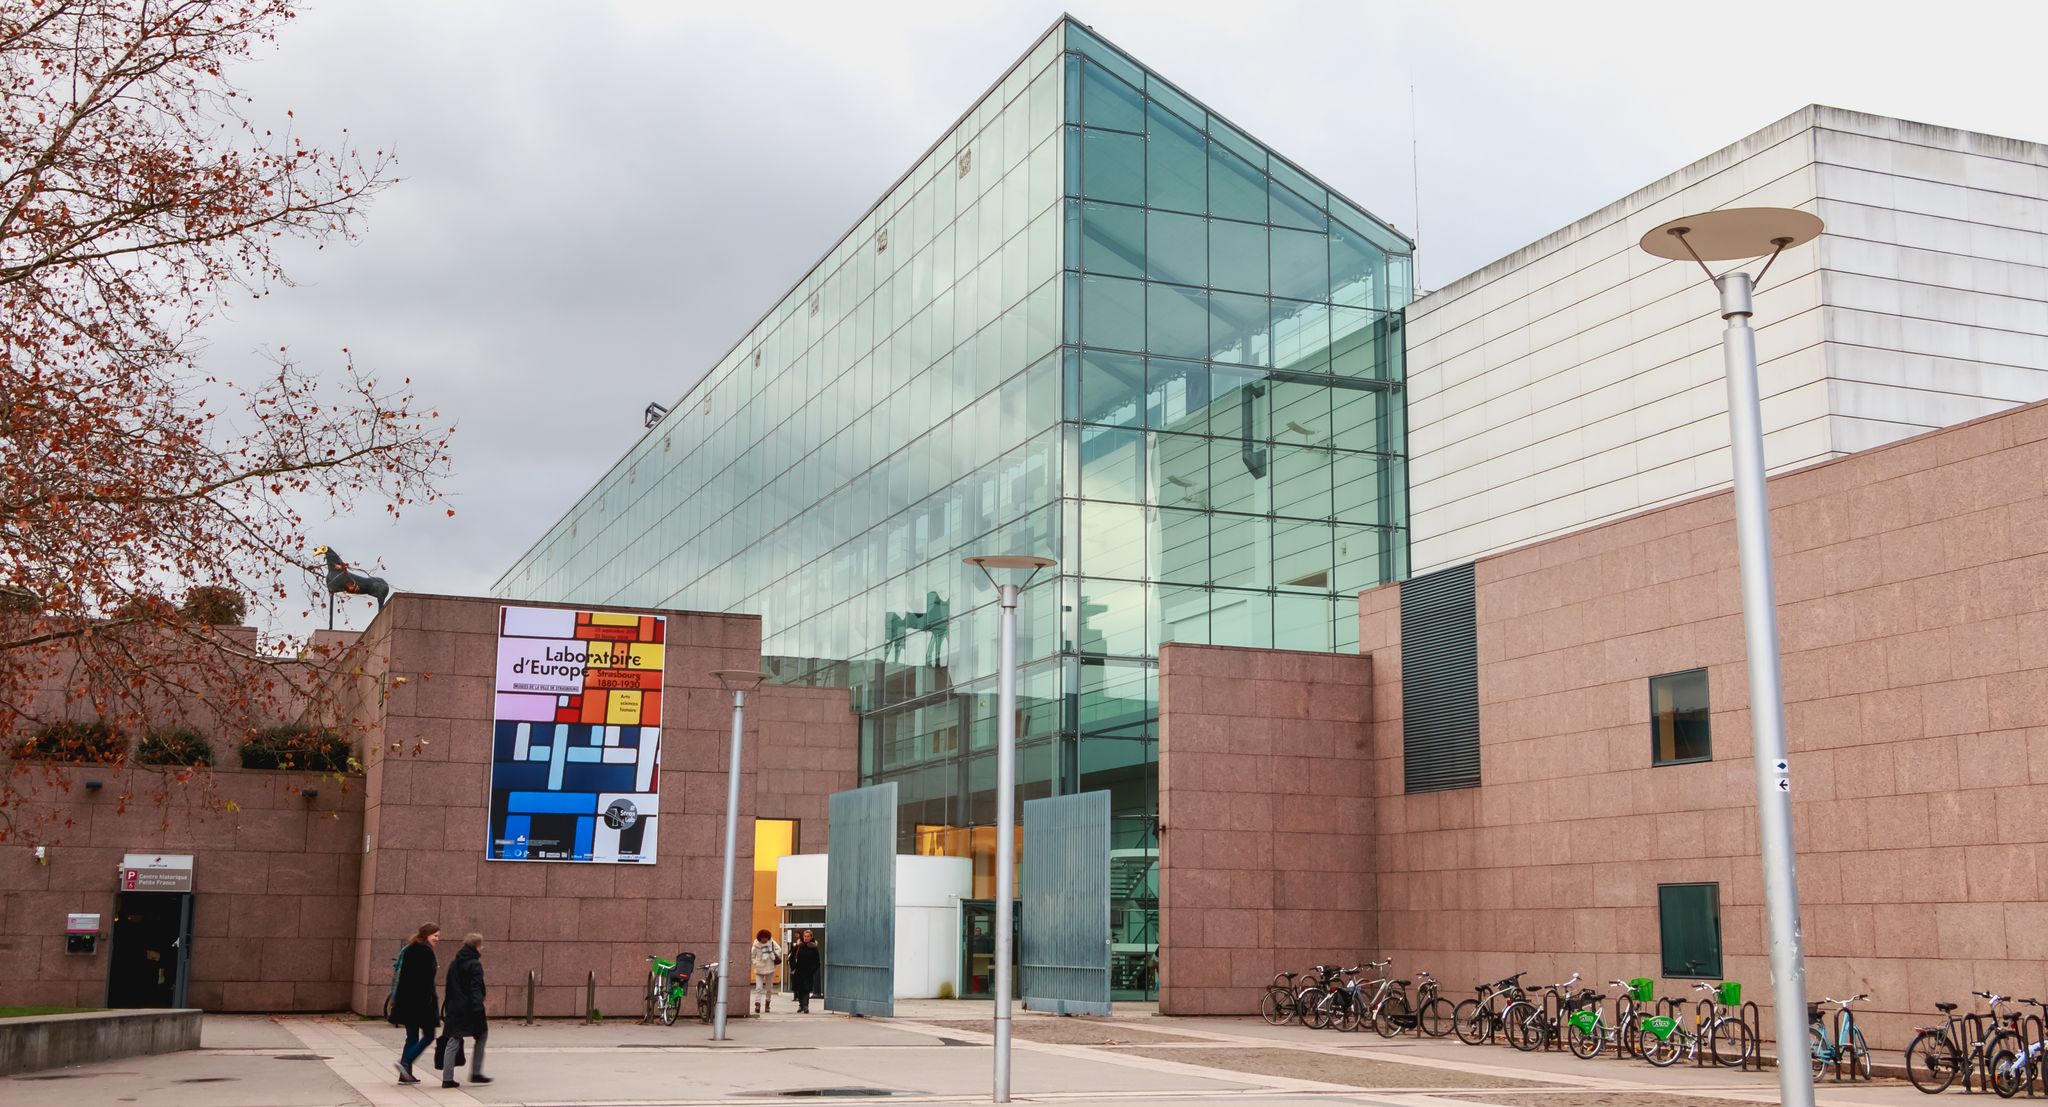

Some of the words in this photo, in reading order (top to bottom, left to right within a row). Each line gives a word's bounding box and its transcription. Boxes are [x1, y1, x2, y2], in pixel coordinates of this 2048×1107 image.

[546, 646, 641, 666] Laboratoire
[597, 669, 641, 680] Strasbourg
[598, 679, 641, 689] 1880-1930
[128, 871, 136, 880] P
